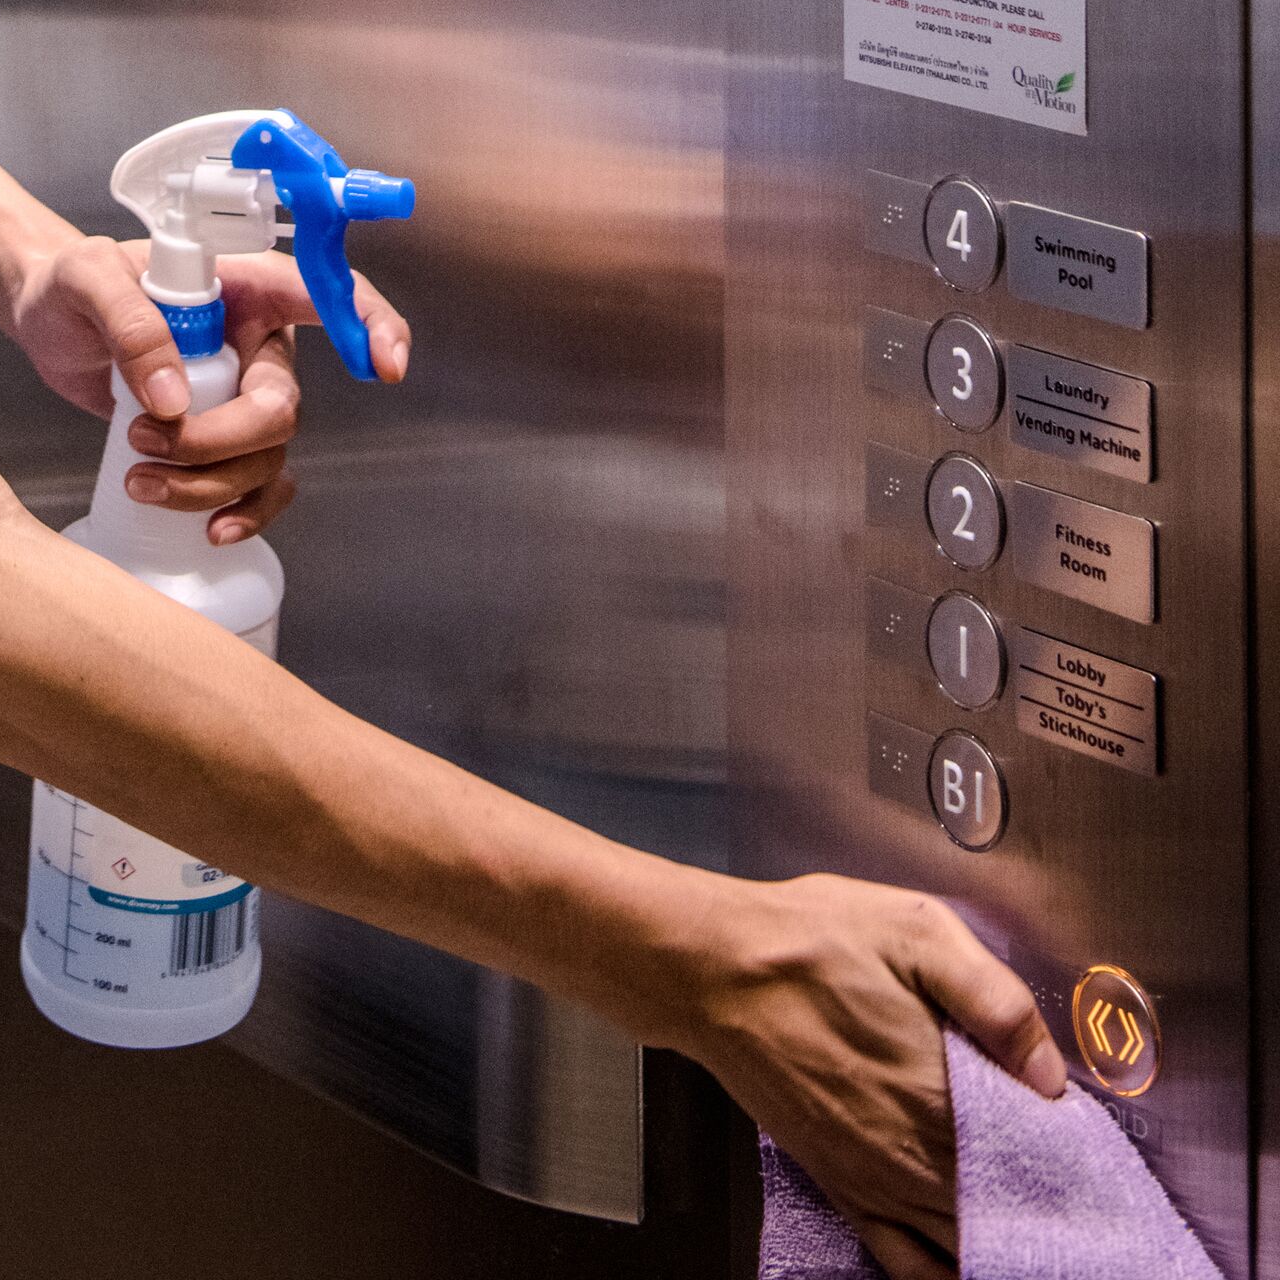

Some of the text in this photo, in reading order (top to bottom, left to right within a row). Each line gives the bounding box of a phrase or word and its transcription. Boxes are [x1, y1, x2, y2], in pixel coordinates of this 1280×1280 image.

[1001, 3, 1025, 16] PLEASE
[1028, 9, 1045, 20] CALL
[1008, 21, 1026, 34] HOUR
[859, 54, 892, 68] MITSUBISHI
[893, 61, 925, 76] ELEVATOR
[1012, 66, 1055, 91] Quality
[1034, 87, 1076, 114] Motion
[946, 210, 971, 262] 4
[1035, 236, 1116, 272] Swimming
[1059, 269, 1093, 290] Pool
[952, 347, 972, 399] 3
[1045, 376, 1109, 409] Laundry
[1016, 410, 1141, 462] Vending Machine
[952, 486, 975, 540] 2
[1055, 525, 1111, 556] Fitness
[1060, 552, 1107, 582] Room
[1057, 654, 1106, 687] Lobby
[1056, 687, 1107, 719] Toby's
[1039, 712, 1124, 757] Stickhouse
[943, 759, 983, 823] B1
[96, 932, 131, 948] 200 ml
[92, 978, 128, 993] 100 ml
